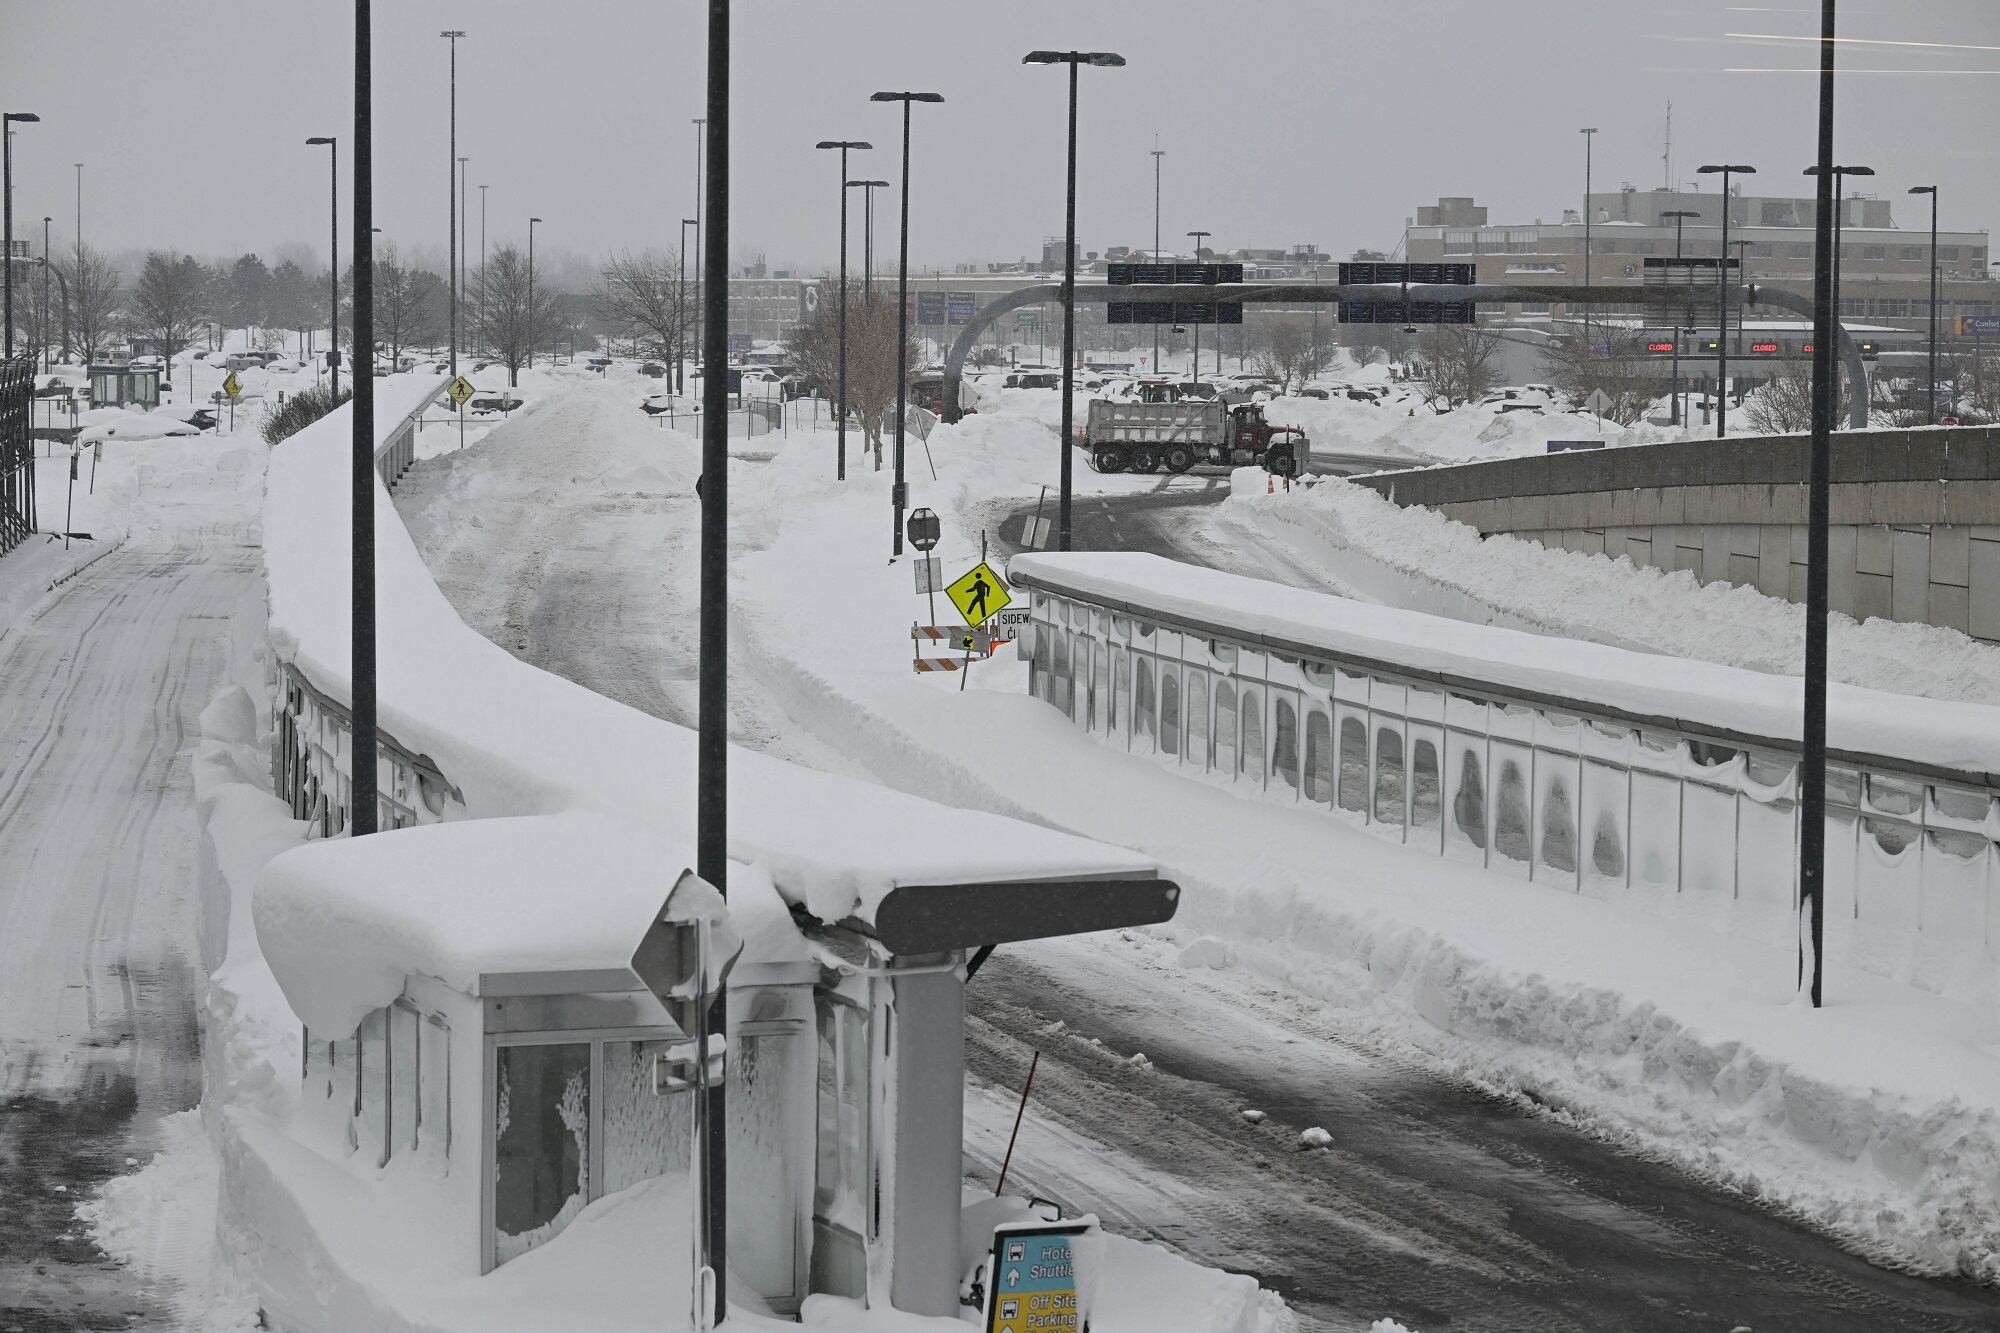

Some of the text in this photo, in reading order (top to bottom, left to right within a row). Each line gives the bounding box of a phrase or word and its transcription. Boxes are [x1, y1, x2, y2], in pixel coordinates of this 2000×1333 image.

[1975, 320, 2000, 328] Comfort
[1752, 344, 1777, 352] CLOSED
[1029, 1293, 1077, 1310] Off Site
[1026, 1312, 1077, 1328] Parking
